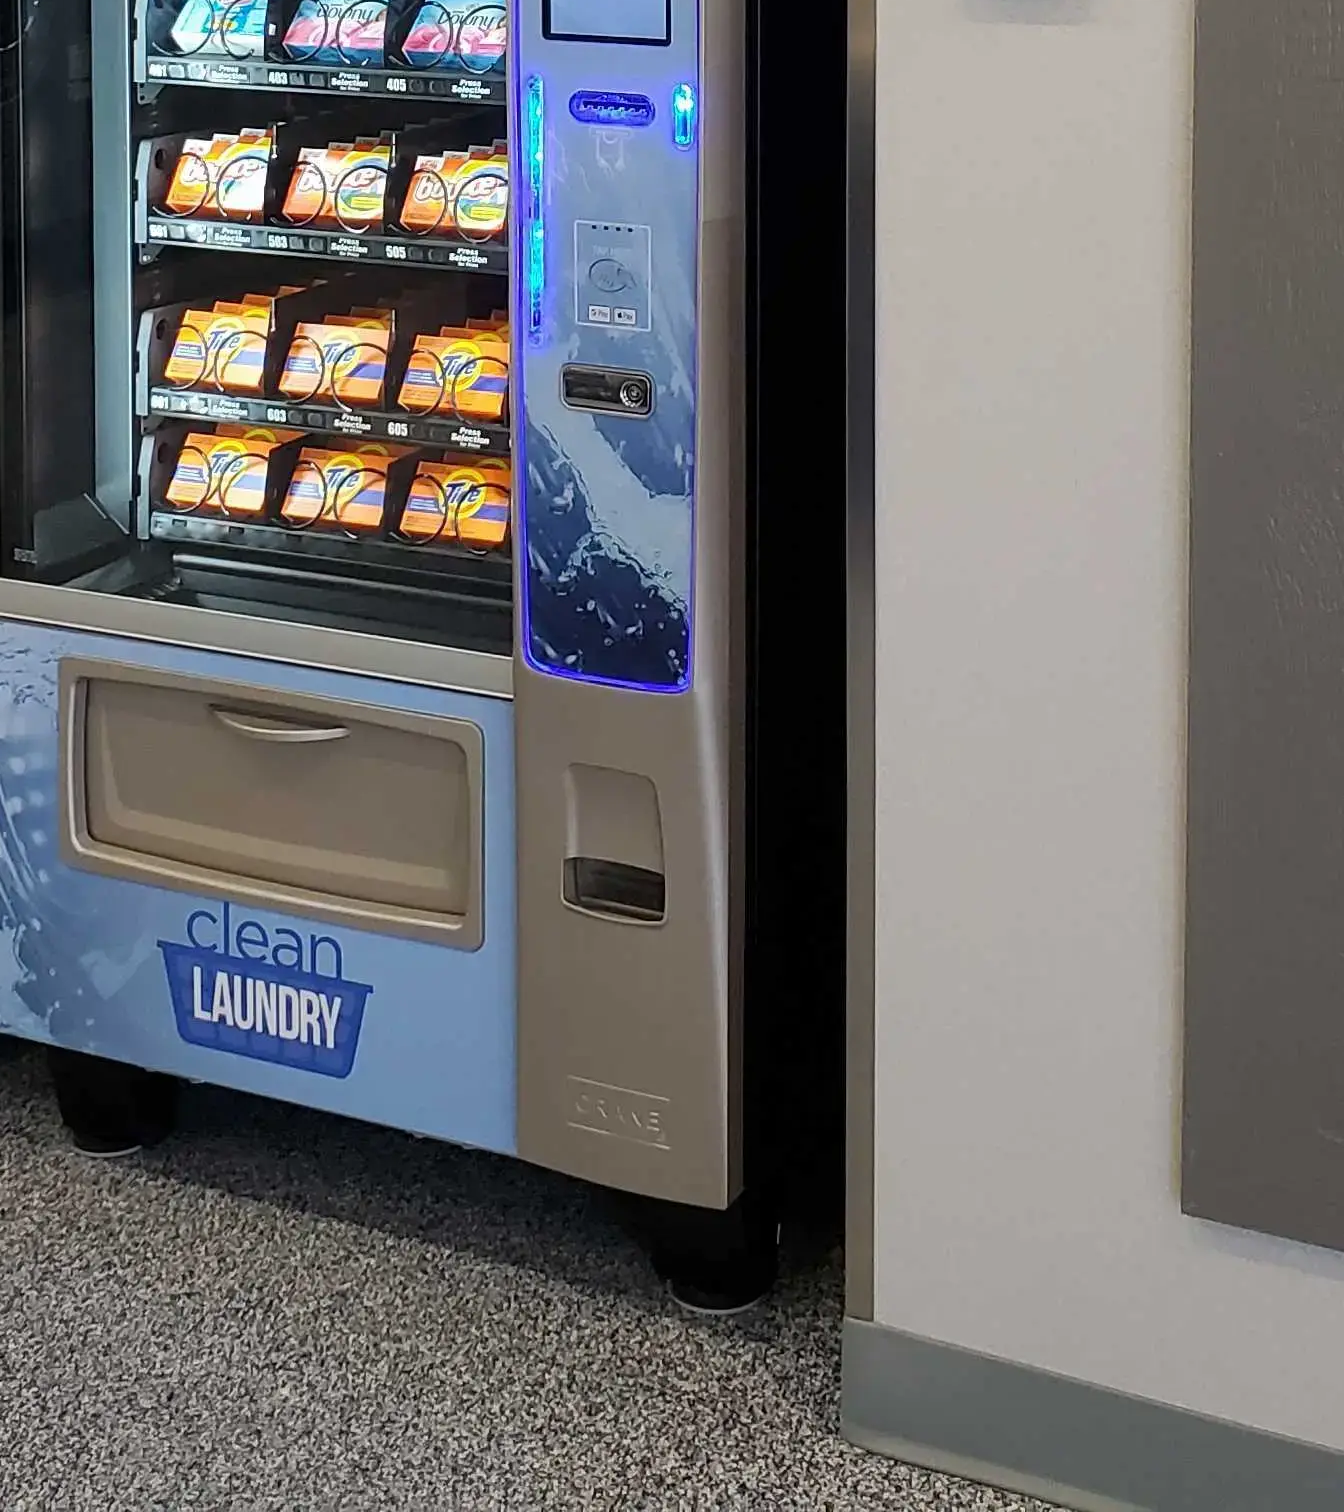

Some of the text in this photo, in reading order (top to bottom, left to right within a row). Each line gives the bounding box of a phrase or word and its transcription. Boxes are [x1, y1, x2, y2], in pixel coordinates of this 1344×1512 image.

[386, 78, 406, 91] 405
[388, 422, 407, 436] 605
[186, 901, 343, 980] clean
[193, 966, 342, 1049] LAUNDRY
